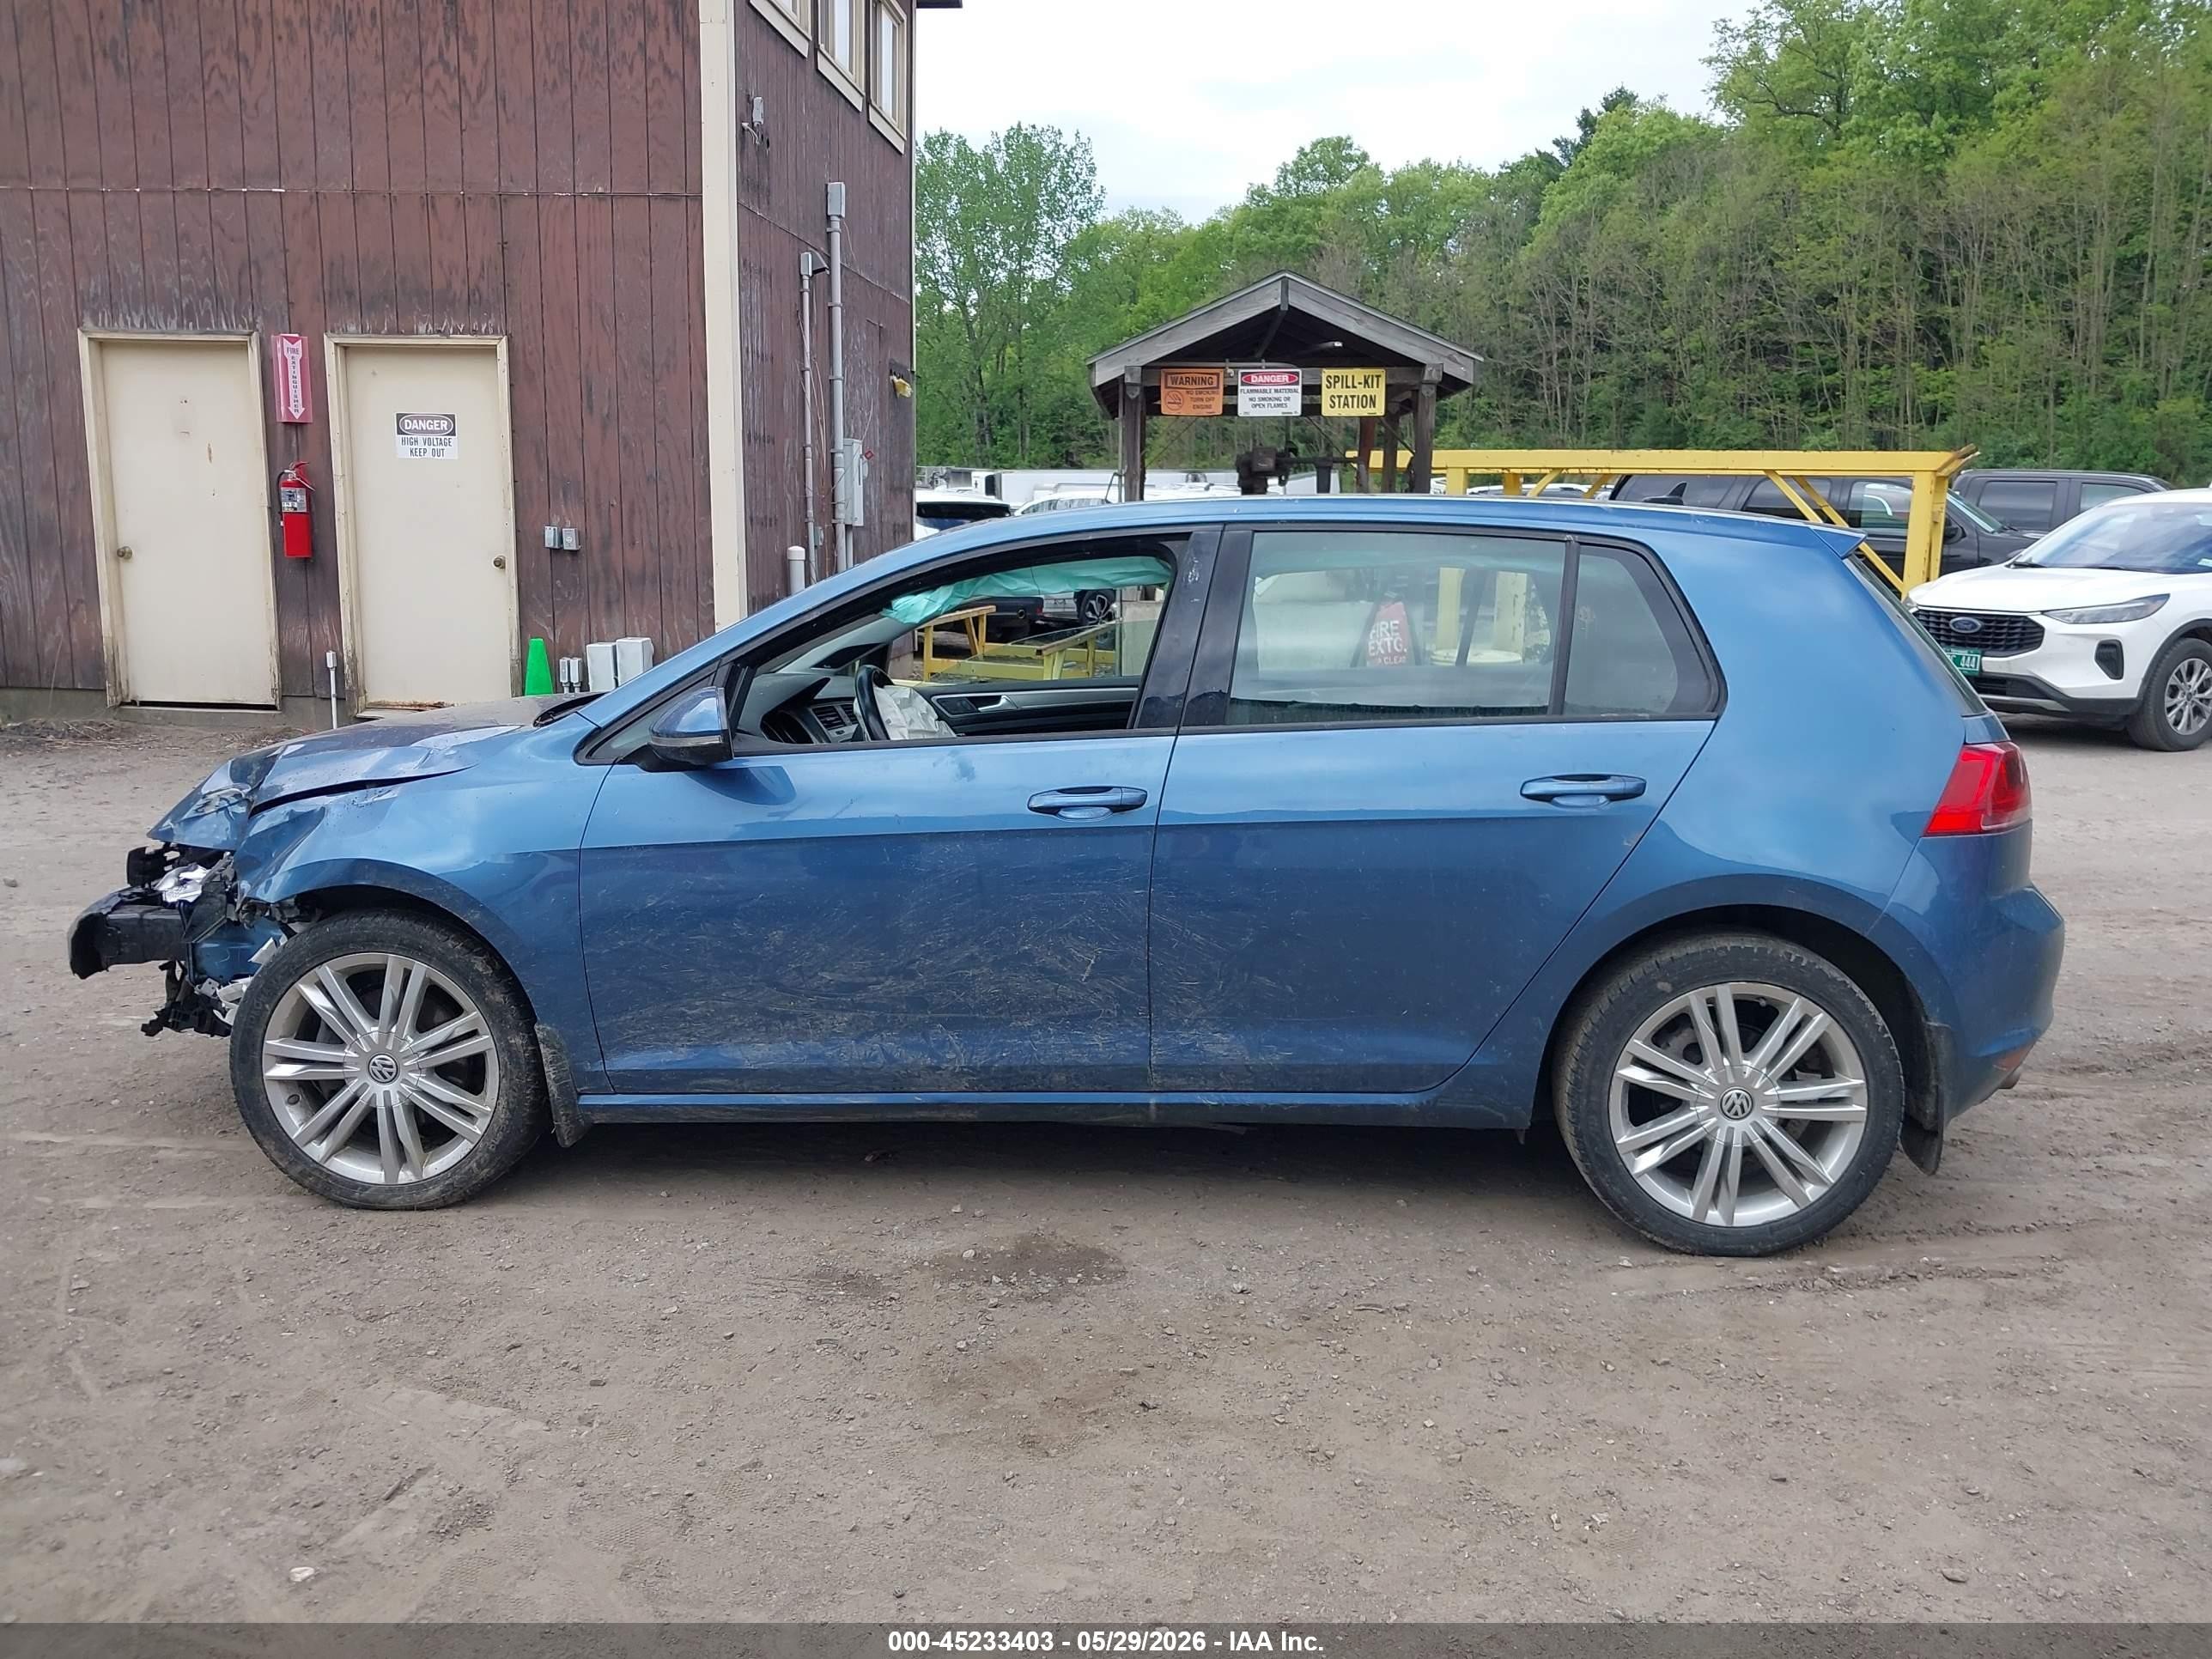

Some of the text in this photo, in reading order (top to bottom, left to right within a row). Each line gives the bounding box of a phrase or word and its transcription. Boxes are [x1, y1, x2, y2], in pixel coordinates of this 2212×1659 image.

[291, 356, 300, 413] EXTINGUISHER
[1170, 376, 1214, 386] WARNING
[1250, 374, 1290, 383] DANGER
[1326, 374, 1382, 389] SPILL-KIT
[1329, 394, 1376, 409] STATION
[404, 419, 448, 431] DANGER
[401, 436, 453, 447] HIGH VOLTAGE
[410, 447, 446, 458] KEEP OUT
[1960, 655, 1976, 668] 444
